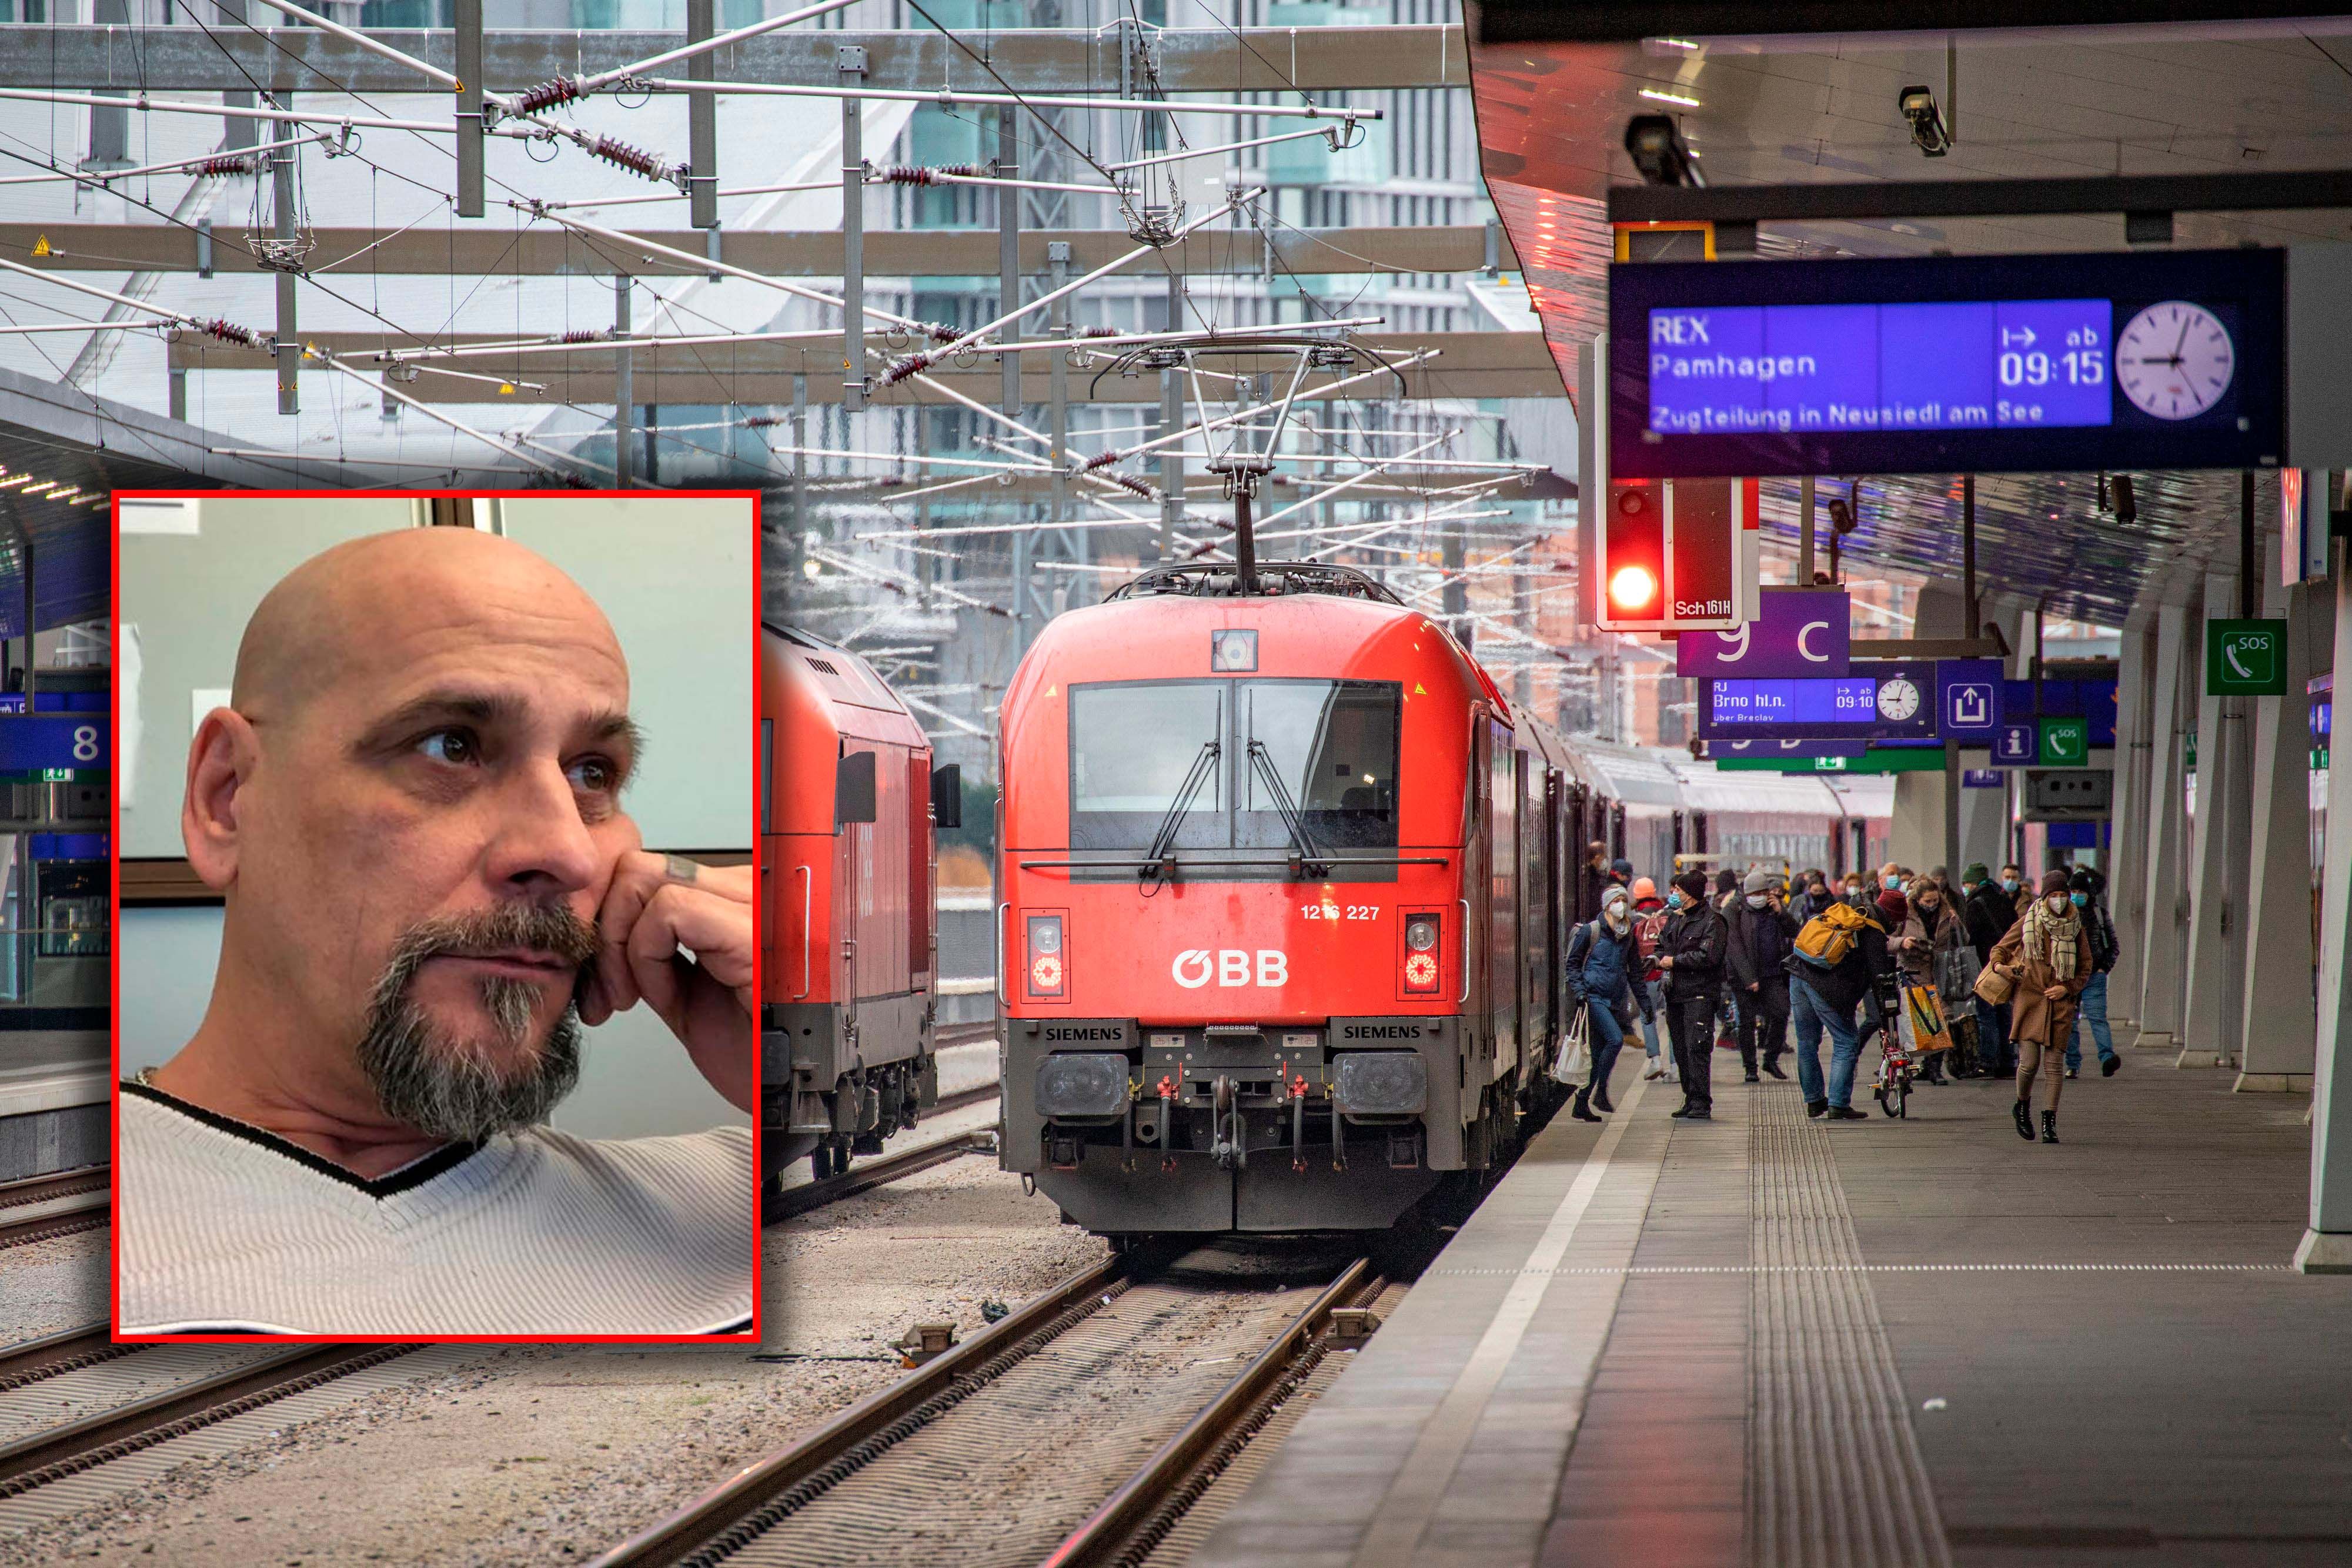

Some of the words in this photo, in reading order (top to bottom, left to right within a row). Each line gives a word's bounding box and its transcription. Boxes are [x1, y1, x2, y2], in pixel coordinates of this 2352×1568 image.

[1651, 316, 1709, 345] REX
[2066, 326, 2099, 347] ab
[1651, 354, 1816, 382] Pamhagen
[1999, 350, 2105, 387] 09:15
[1651, 405, 1792, 433] Zugteilung
[1799, 403, 1822, 426] in
[1829, 401, 1942, 426] Neusiedl
[1949, 403, 1988, 423] am
[1996, 400, 2043, 423] See
[1675, 601, 1705, 615] Sch
[1706, 600, 1731, 615] 161H
[1716, 621, 1750, 662] 9
[1798, 621, 1829, 662] C
[2238, 637, 2269, 650] SOS
[1713, 681, 1728, 693] RJ
[1713, 694, 1749, 708] Brno
[1755, 694, 1786, 708] hl.n.
[1836, 696, 1874, 708] 09:10
[1738, 713, 1774, 722] Breclav
[2058, 728, 2076, 738] SOS
[73, 726, 99, 761] 8
[1301, 905, 1340, 920] 1216
[1347, 905, 1380, 920] 227
[1172, 949, 1289, 988] ÖBB
[1045, 1027, 1122, 1041] SIEMENS
[1344, 1025, 1420, 1041] SIEMENS
